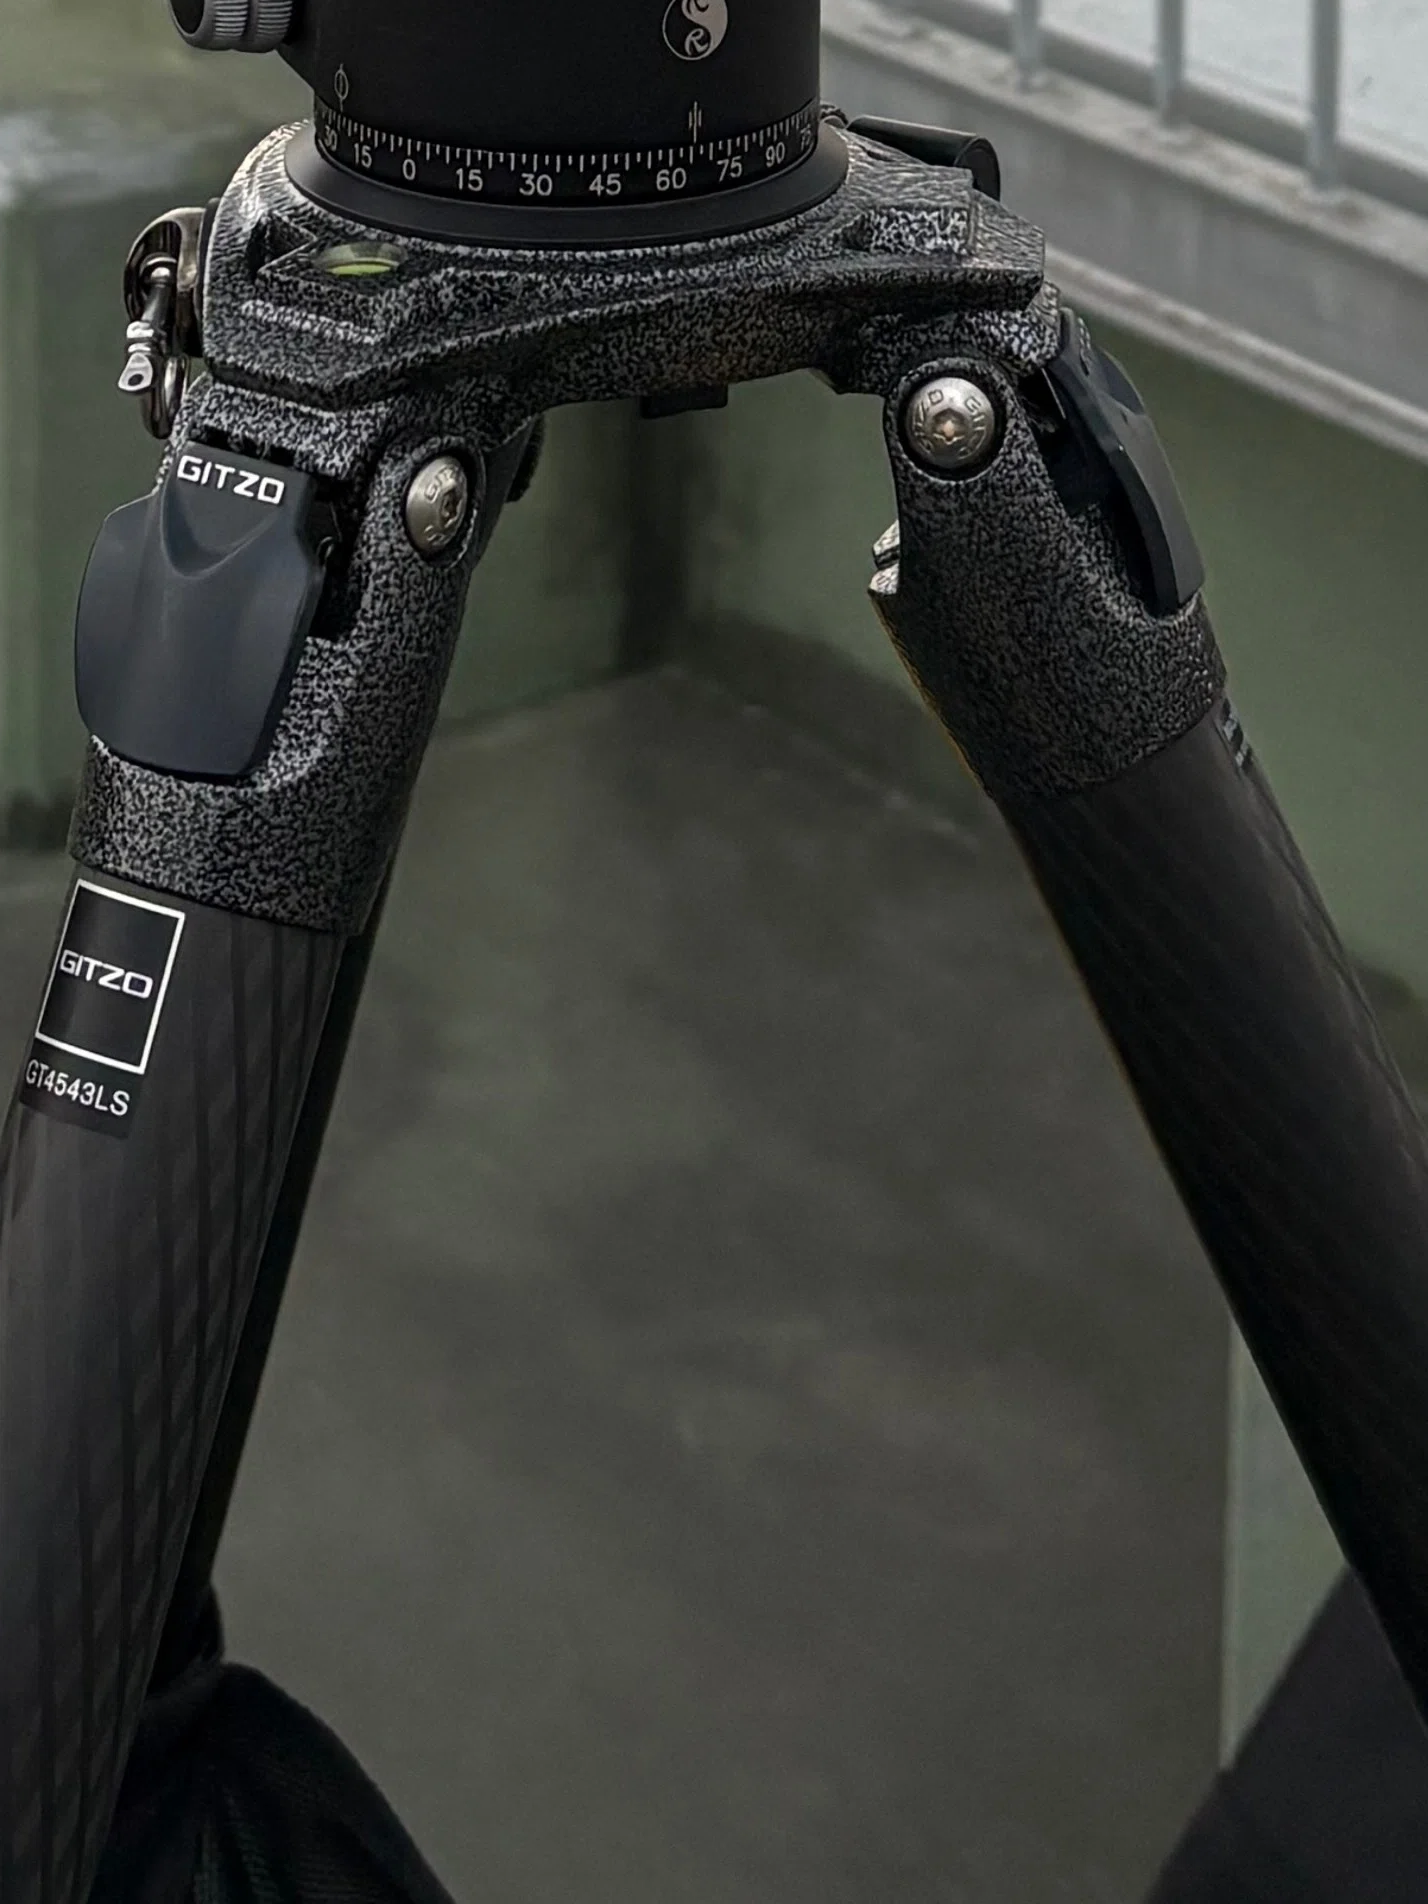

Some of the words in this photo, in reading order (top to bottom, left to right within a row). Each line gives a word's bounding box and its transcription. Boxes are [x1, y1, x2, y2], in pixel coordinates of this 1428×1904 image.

[353, 142, 373, 169] 15
[402, 158, 416, 181] 0
[455, 167, 484, 192] 15
[518, 172, 553, 197] 30
[588, 172, 622, 197] 45
[655, 166, 688, 191] 60
[716, 155, 744, 183] 75
[765, 141, 786, 168] 90
[176, 454, 286, 506] GITZO
[58, 948, 154, 1000] GITZO
[25, 1058, 131, 1117] GT4543LS
